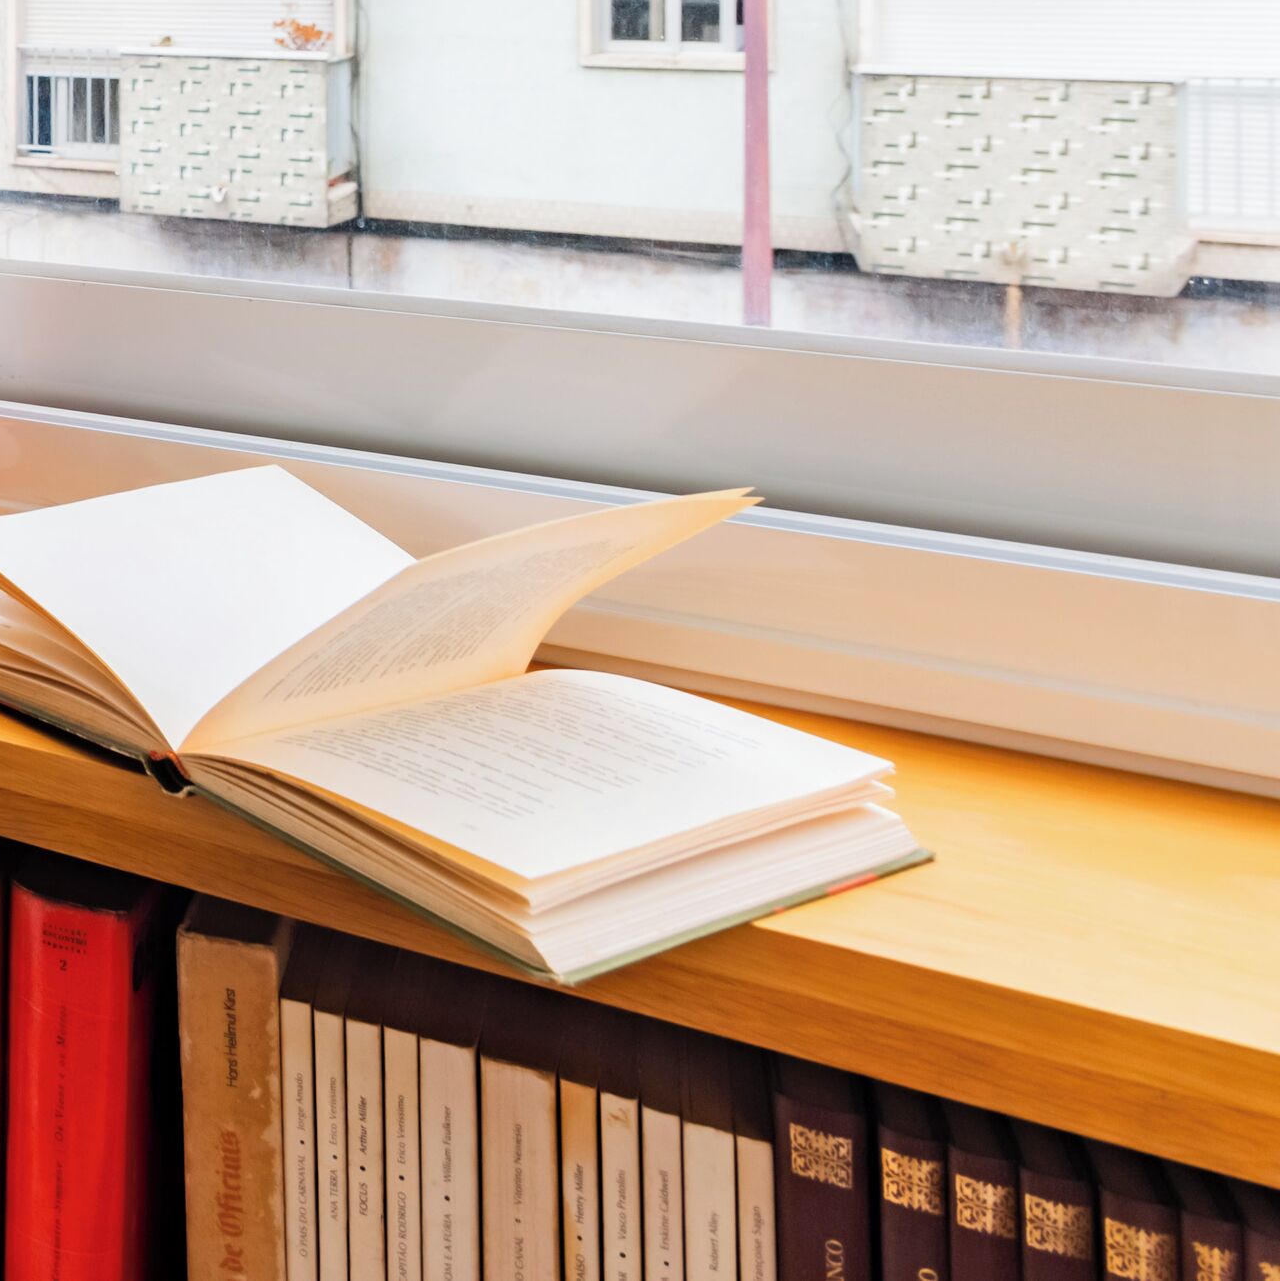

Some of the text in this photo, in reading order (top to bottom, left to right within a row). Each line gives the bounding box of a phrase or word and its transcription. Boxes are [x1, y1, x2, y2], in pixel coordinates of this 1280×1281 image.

[59, 958, 68, 972] 2
[223, 988, 239, 1087] Hans Hellmut Kirst
[293, 1072, 304, 1106] Amado
[295, 1106, 307, 1132] Jorge
[441, 1105, 452, 1146] Faulkner
[357, 1095, 368, 1217] FOCUS Arthur Miller
[442, 1147, 452, 1183] William
[295, 1154, 307, 1205] CARNAVAL
[328, 1169, 338, 1197] TERRA
[513, 1167, 523, 1206] Vitorino
[573, 1163, 585, 1194] Miller
[214, 1127, 244, 1275] de Oficiais
[297, 1207, 307, 1224] DO
[328, 1199, 339, 1222] ANA
[397, 1191, 407, 1240] RODRIGO
[575, 1195, 586, 1225] Henry
[615, 1168, 628, 1240] Vasco Pratolini
[657, 1168, 670, 1251] Erskine Caldwell
[752, 1205, 764, 1237] Sagan
[298, 1247, 308, 1258] O
[443, 1244, 452, 1253] A
[514, 1236, 524, 1269] CANAL
[708, 1211, 720, 1272] Robert Alley
